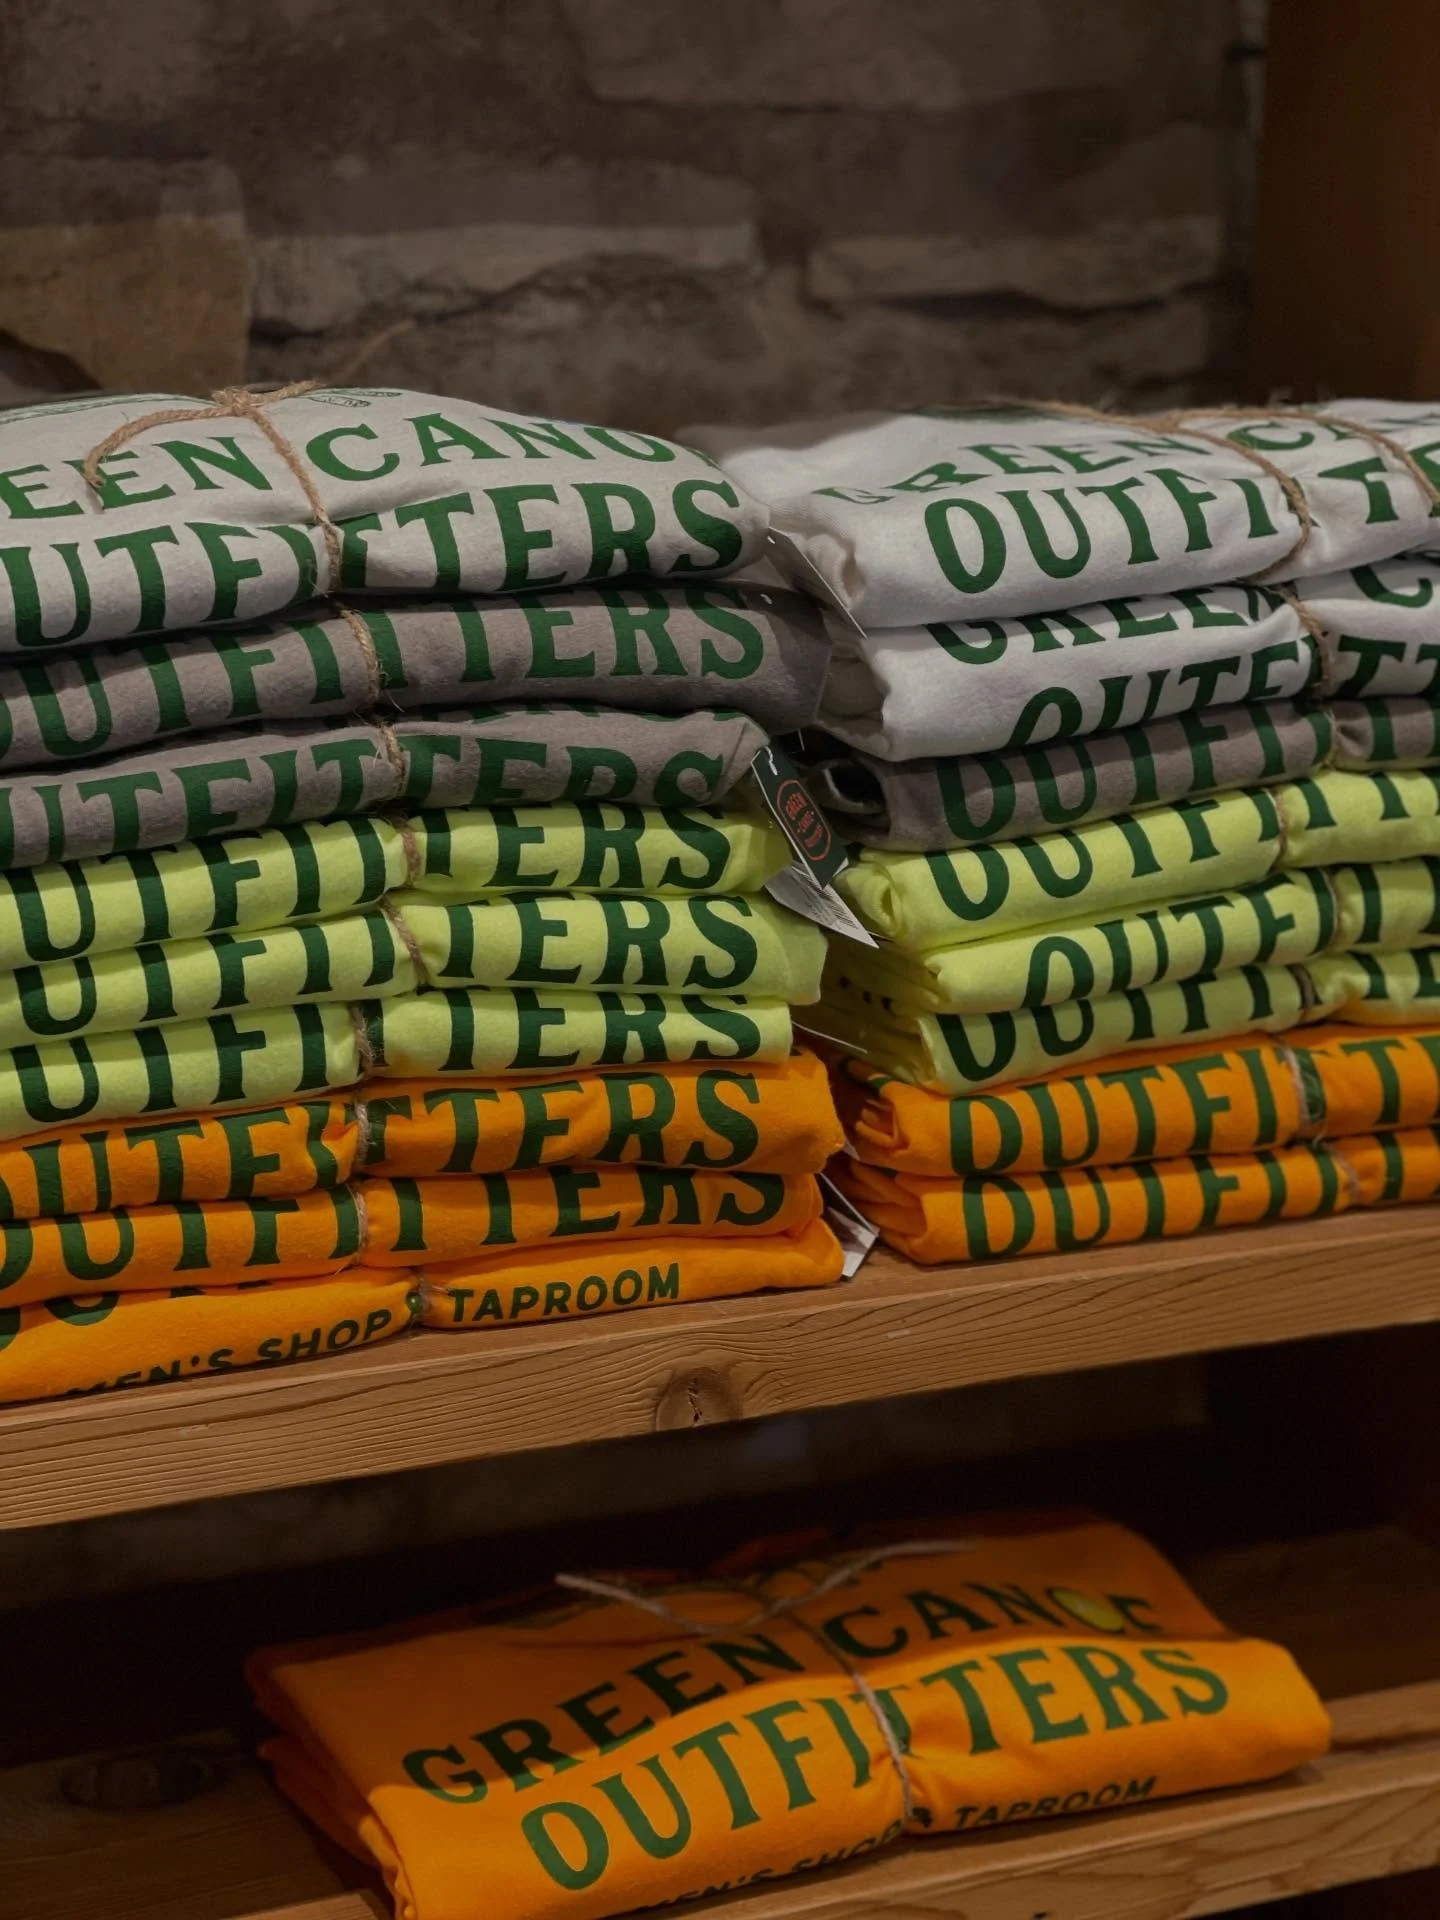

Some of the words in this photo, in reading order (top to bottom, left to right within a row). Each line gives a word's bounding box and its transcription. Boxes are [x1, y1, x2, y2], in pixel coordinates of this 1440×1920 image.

[812, 437, 1213, 505] GREEN
[257, 1308, 392, 1366] SHOP
[449, 1263, 680, 1322] TAPROOM
[402, 1634, 806, 1804] GREEN
[520, 1646, 1229, 1891] OUTFITTERS
